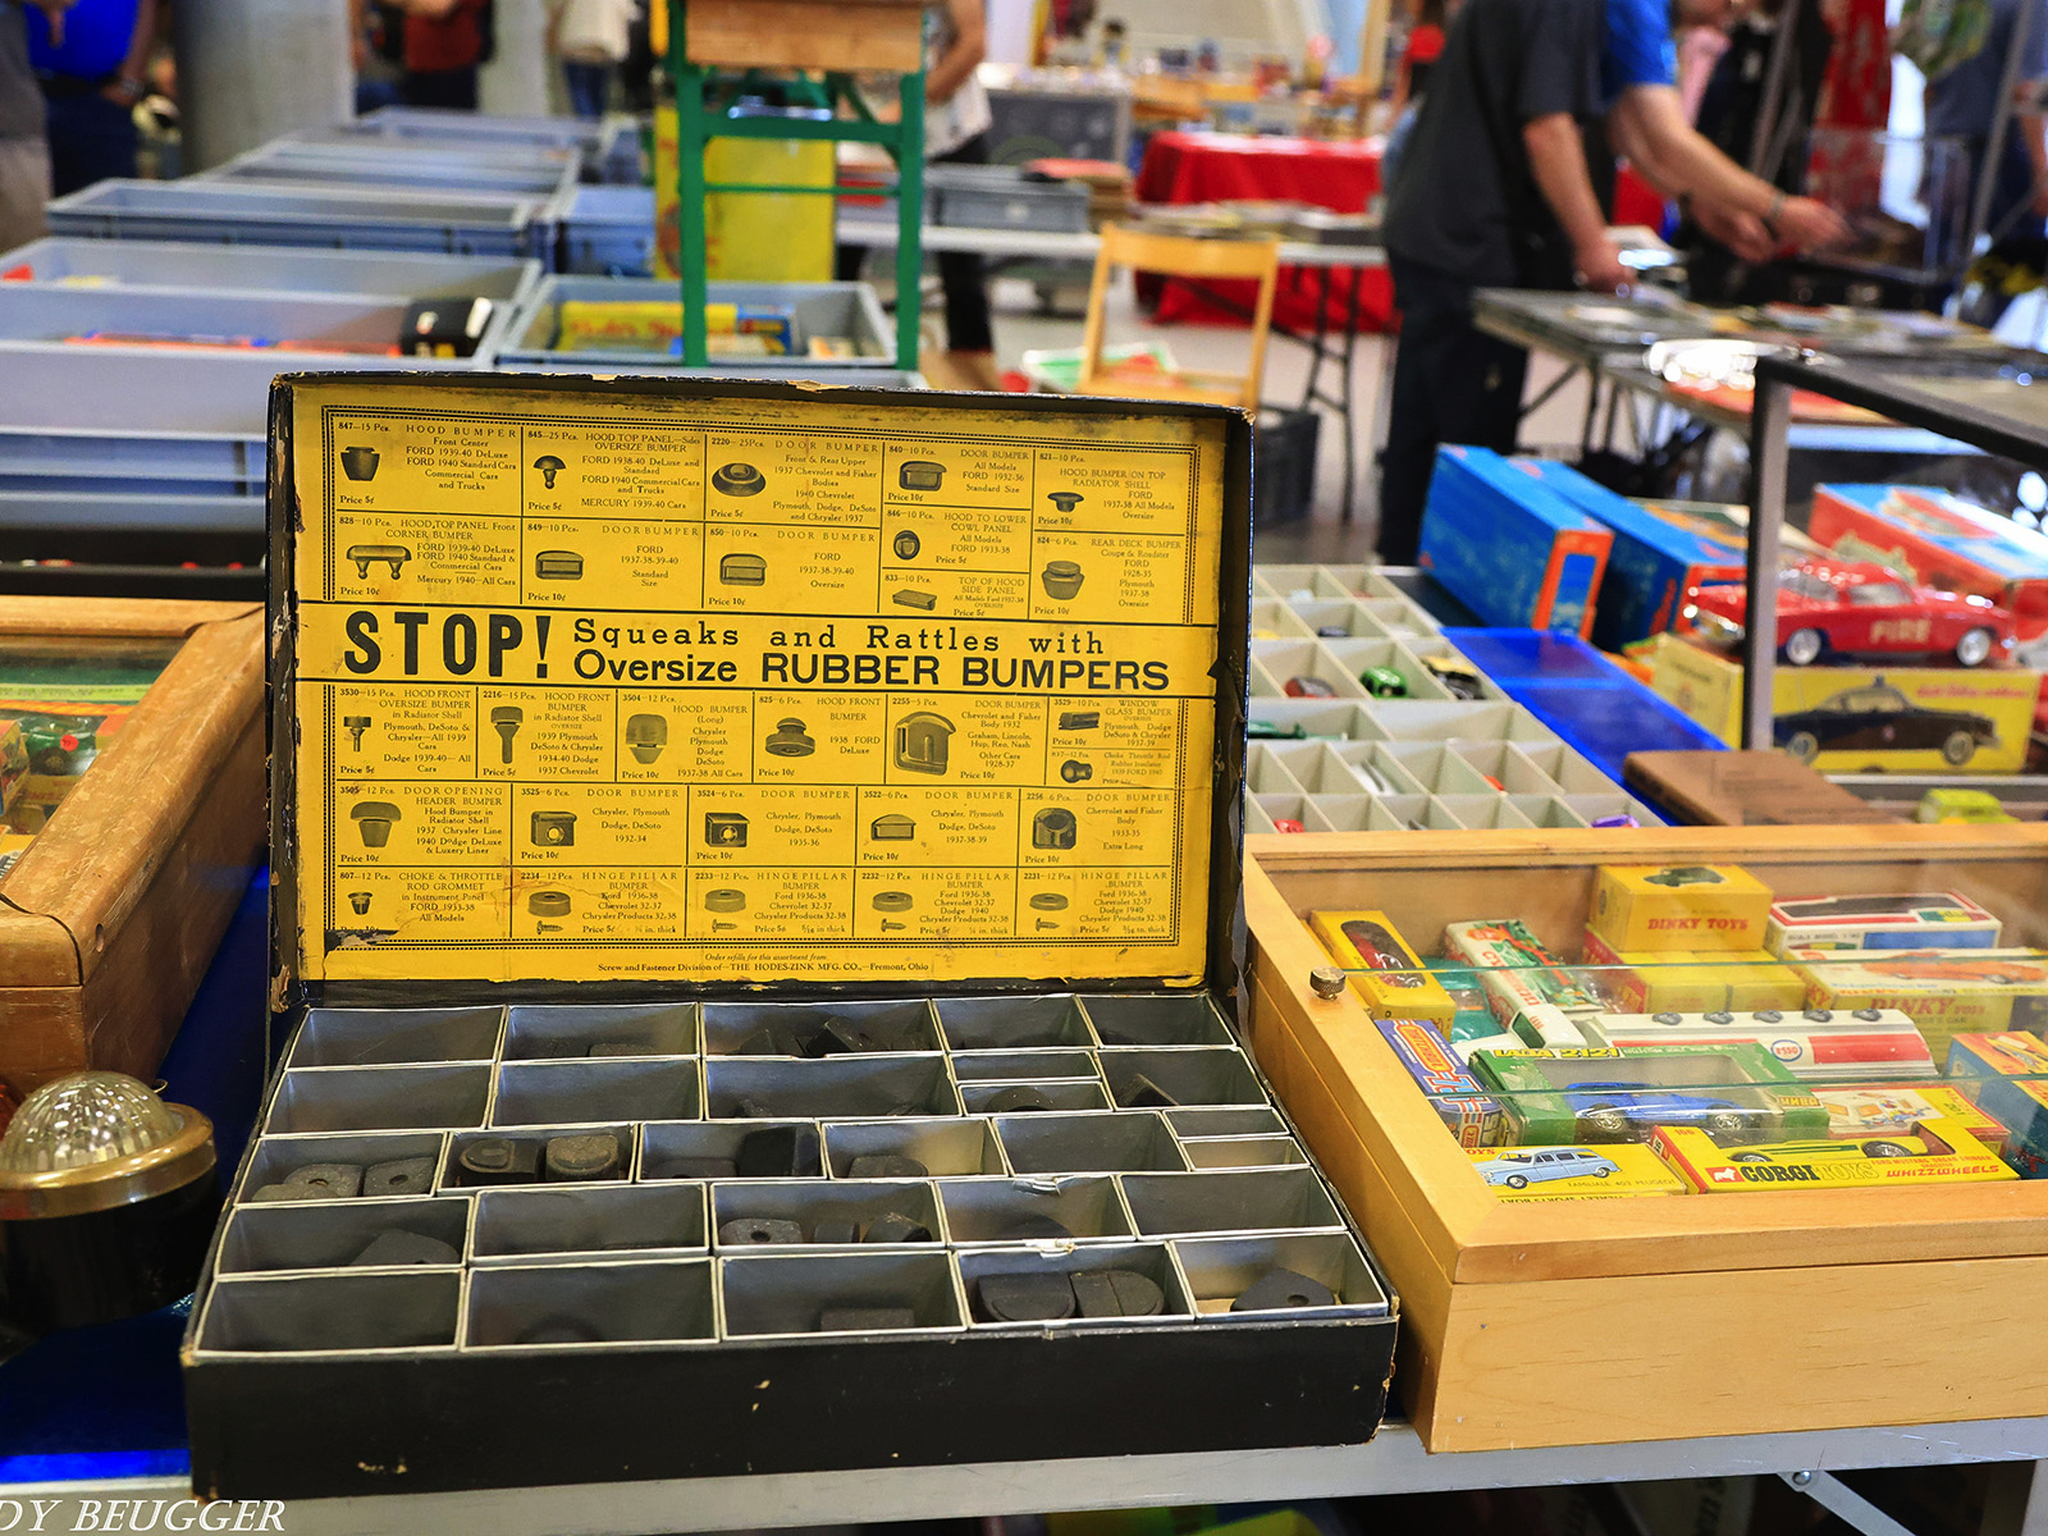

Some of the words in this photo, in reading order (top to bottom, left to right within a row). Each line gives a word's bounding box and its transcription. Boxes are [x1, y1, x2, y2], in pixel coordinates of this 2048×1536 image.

[406, 424, 446, 434] HOOD
[453, 426, 516, 438] BUMPER
[433, 436, 456, 446] Front
[460, 437, 489, 447] Center
[594, 439, 642, 451] OVERSIZE
[646, 442, 686, 453] BUMPER
[960, 448, 988, 458] DOOR
[992, 450, 1029, 459] BUMPER
[785, 454, 806, 463] Front
[808, 455, 817, 463] &
[820, 455, 839, 464] Rear
[840, 456, 866, 466] Upper
[424, 468, 474, 479] Commercial
[479, 471, 498, 480] Cars
[962, 470, 988, 480] FORD
[994, 472, 1024, 481] 1932-36
[1059, 467, 1088, 477] HOOD
[1091, 469, 1127, 478] BUMPER
[1130, 470, 1144, 479] ON
[1148, 471, 1166, 479] TOP
[965, 483, 1000, 492] Standard
[1004, 484, 1020, 493] Size
[1073, 478, 1120, 487] RADIATOR
[1124, 480, 1150, 489] SHELL
[581, 497, 630, 508] MERCURY
[633, 499, 665, 508] 1939-40
[666, 500, 686, 509] Cars
[944, 512, 973, 521] HOOD
[976, 513, 990, 522] TO
[993, 514, 1027, 524] LOWER
[950, 522, 979, 532] COWL
[983, 524, 1012, 533] PANEL
[385, 528, 429, 539] CORNER
[432, 530, 473, 540] BUMPER
[777, 530, 815, 539] DOOR
[822, 532, 875, 542] BUMPER
[417, 541, 445, 554] FORD
[448, 543, 481, 555] 1939-40
[483, 544, 515, 556] DeLuxe
[1091, 538, 1115, 547] REAR
[1118, 539, 1142, 547] DECK
[1146, 540, 1181, 549] BUMPER
[636, 544, 664, 554] FORD
[814, 552, 841, 561] FORD
[1124, 558, 1150, 567] FORD
[632, 569, 668, 580] Standard
[640, 578, 657, 587] Size
[810, 579, 844, 588] Oversize
[958, 576, 977, 587] TOP
[979, 577, 992, 585] OF
[996, 578, 1025, 586] HOOD
[962, 585, 981, 593] SIDE
[987, 586, 1015, 594] PANEL
[574, 618, 739, 648] Squeaks
[770, 625, 836, 648] and
[867, 625, 999, 651] Rattles
[1029, 631, 1104, 654] with
[344, 610, 551, 678] STOP!
[574, 648, 737, 681] Oversize
[762, 653, 940, 685] RUBBER
[963, 656, 1170, 690] BUMPERS
[378, 699, 427, 708] OVERSIZE
[431, 700, 471, 709] BUMPER
[547, 702, 587, 711] BUMPER
[816, 697, 846, 705] HOOD
[849, 697, 881, 706] FRONT
[975, 700, 1002, 708] DOOR
[1005, 701, 1041, 709] BUMPER
[1118, 699, 1157, 707] WINDOW
[403, 710, 439, 719] Radiator
[441, 710, 462, 719] Shell
[829, 712, 867, 721] BUMPER
[1105, 707, 1133, 715] GLASS
[1137, 708, 1171, 718] BUMPER
[692, 727, 726, 737] Chrysler
[689, 737, 728, 747] Plymouth
[830, 735, 848, 744] 1938
[854, 735, 881, 744] FORD
[697, 747, 723, 757] Dodge
[839, 745, 870, 754] DeLuxe
[695, 757, 725, 765] DeSoto
[587, 788, 622, 797] DOOR
[630, 789, 679, 797] BUMPER
[761, 789, 795, 798] DOOR
[803, 790, 850, 799] BUMPER
[925, 791, 958, 799] DOOR
[966, 791, 1013, 799] BUMPER
[1086, 793, 1118, 802] DOOR
[1126, 793, 1170, 801] BUMPER
[415, 796, 456, 805] HEADER
[462, 797, 502, 805] BUMPER
[416, 825, 436, 834] 1937
[442, 826, 479, 835] Chrysler
[483, 826, 502, 834] Line
[774, 824, 802, 834] Dodge,
[804, 825, 832, 833] DeSoto
[615, 834, 646, 842] 1932-34
[398, 872, 434, 880] CHOKE
[438, 872, 446, 880] &
[450, 872, 502, 880] THROTTLE
[757, 872, 798, 880] HINGE
[802, 872, 847, 880] PILLAR
[407, 882, 429, 890] ROD
[433, 882, 484, 890] GROMMET
[782, 882, 819, 890] BUMPER
[774, 891, 793, 899] Ford
[940, 907, 965, 917] Dodge
[971, 905, 989, 914] 1940
[419, 913, 431, 921] All
[433, 913, 464, 922] Models
[1648, 918, 1702, 930] DINKY
[1707, 918, 1750, 930] TOYS
[727, 953, 745, 962] refills
[746, 953, 757, 961] for
[808, 952, 826, 961] from
[597, 963, 623, 971] Screw
[624, 963, 640, 971] and
[641, 963, 676, 972] Fastener
[677, 962, 712, 971] Division
[817, 962, 841, 971] MFG.
[907, 962, 929, 970] Ohio
[1560, 1047, 1621, 1058] 2121
[1740, 1164, 1821, 1183] CORGI
[1819, 1161, 1881, 1180] TOYS
[1887, 1165, 2000, 1179] WHIZZWHEELS
